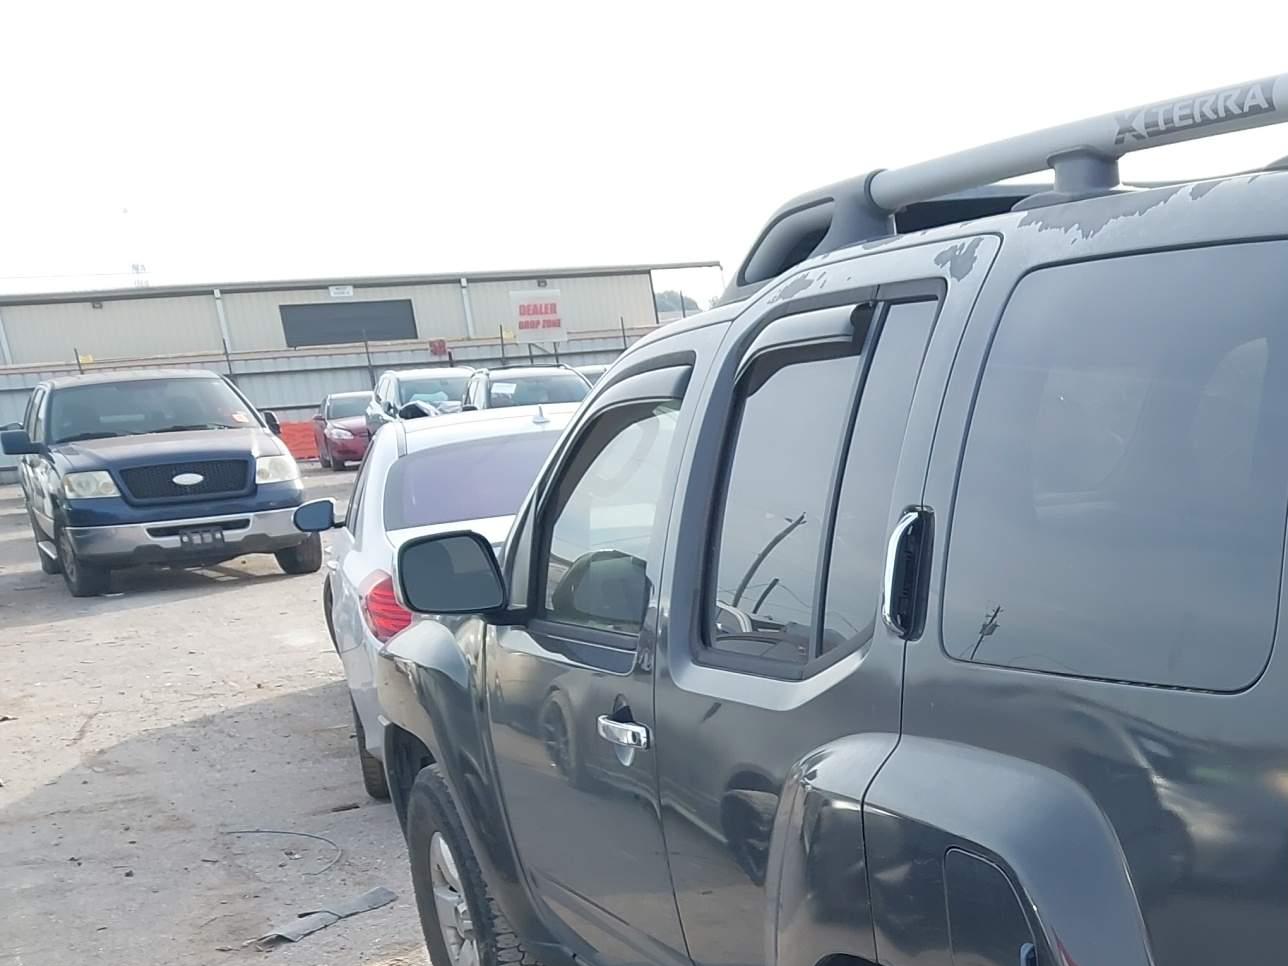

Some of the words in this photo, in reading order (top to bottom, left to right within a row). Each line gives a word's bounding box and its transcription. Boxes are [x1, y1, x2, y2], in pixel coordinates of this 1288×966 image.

[1113, 83, 1270, 145] XTERRA
[519, 303, 557, 315] DEALER
[518, 319, 540, 330] DROP
